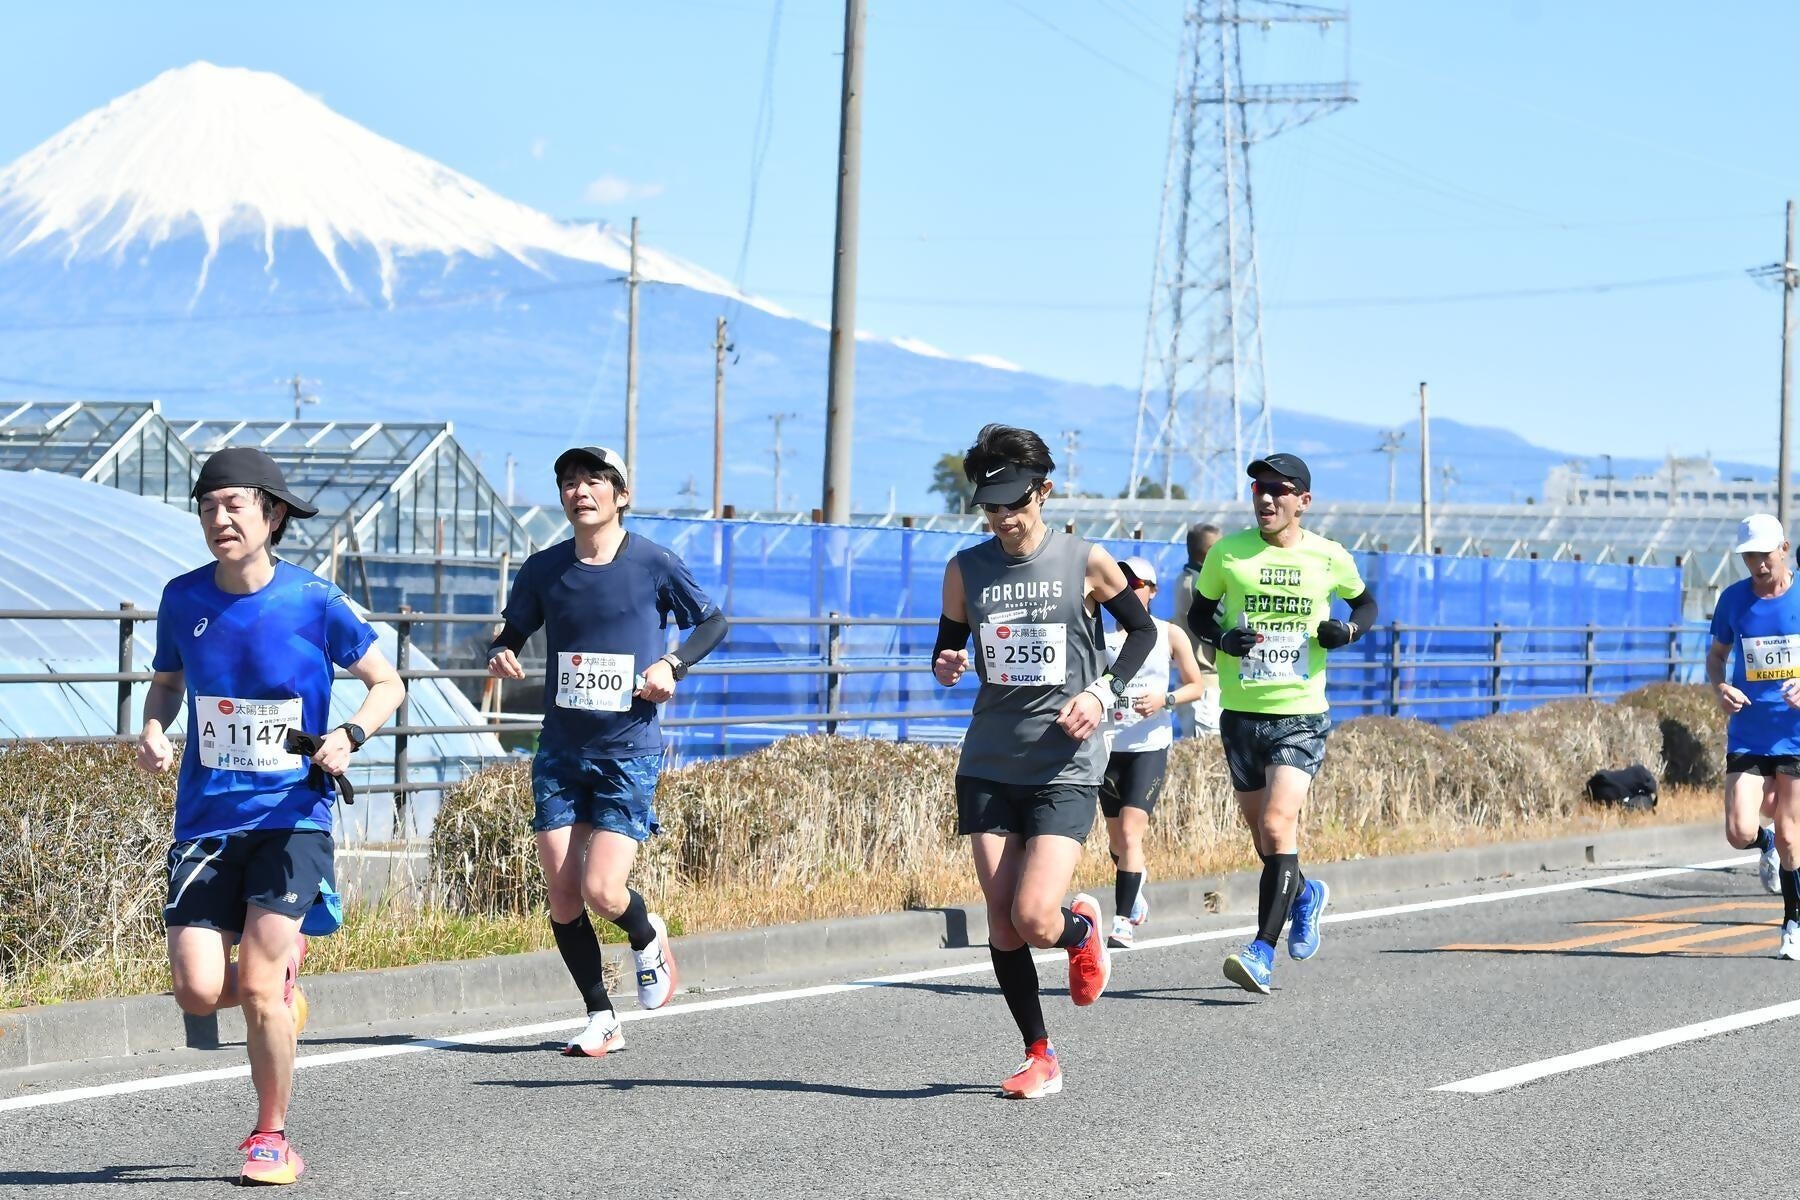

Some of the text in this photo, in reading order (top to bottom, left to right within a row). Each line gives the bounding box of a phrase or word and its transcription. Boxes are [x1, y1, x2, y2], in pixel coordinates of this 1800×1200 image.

[1260, 568, 1301, 586] RUN
[982, 581, 1063, 604] FOROURS
[1245, 595, 1312, 615] EVERY
[1012, 628, 1047, 638] 太陽生命
[985, 645, 1056, 664] B 2550
[1259, 649, 1300, 664] 1099
[1746, 650, 1791, 665] S 611
[561, 672, 622, 691] B 2300
[1757, 669, 1794, 679] KENTEM
[235, 704, 279, 716] 太陽生命
[203, 721, 287, 746] A 1147
[233, 757, 278, 767] PCA Hub
